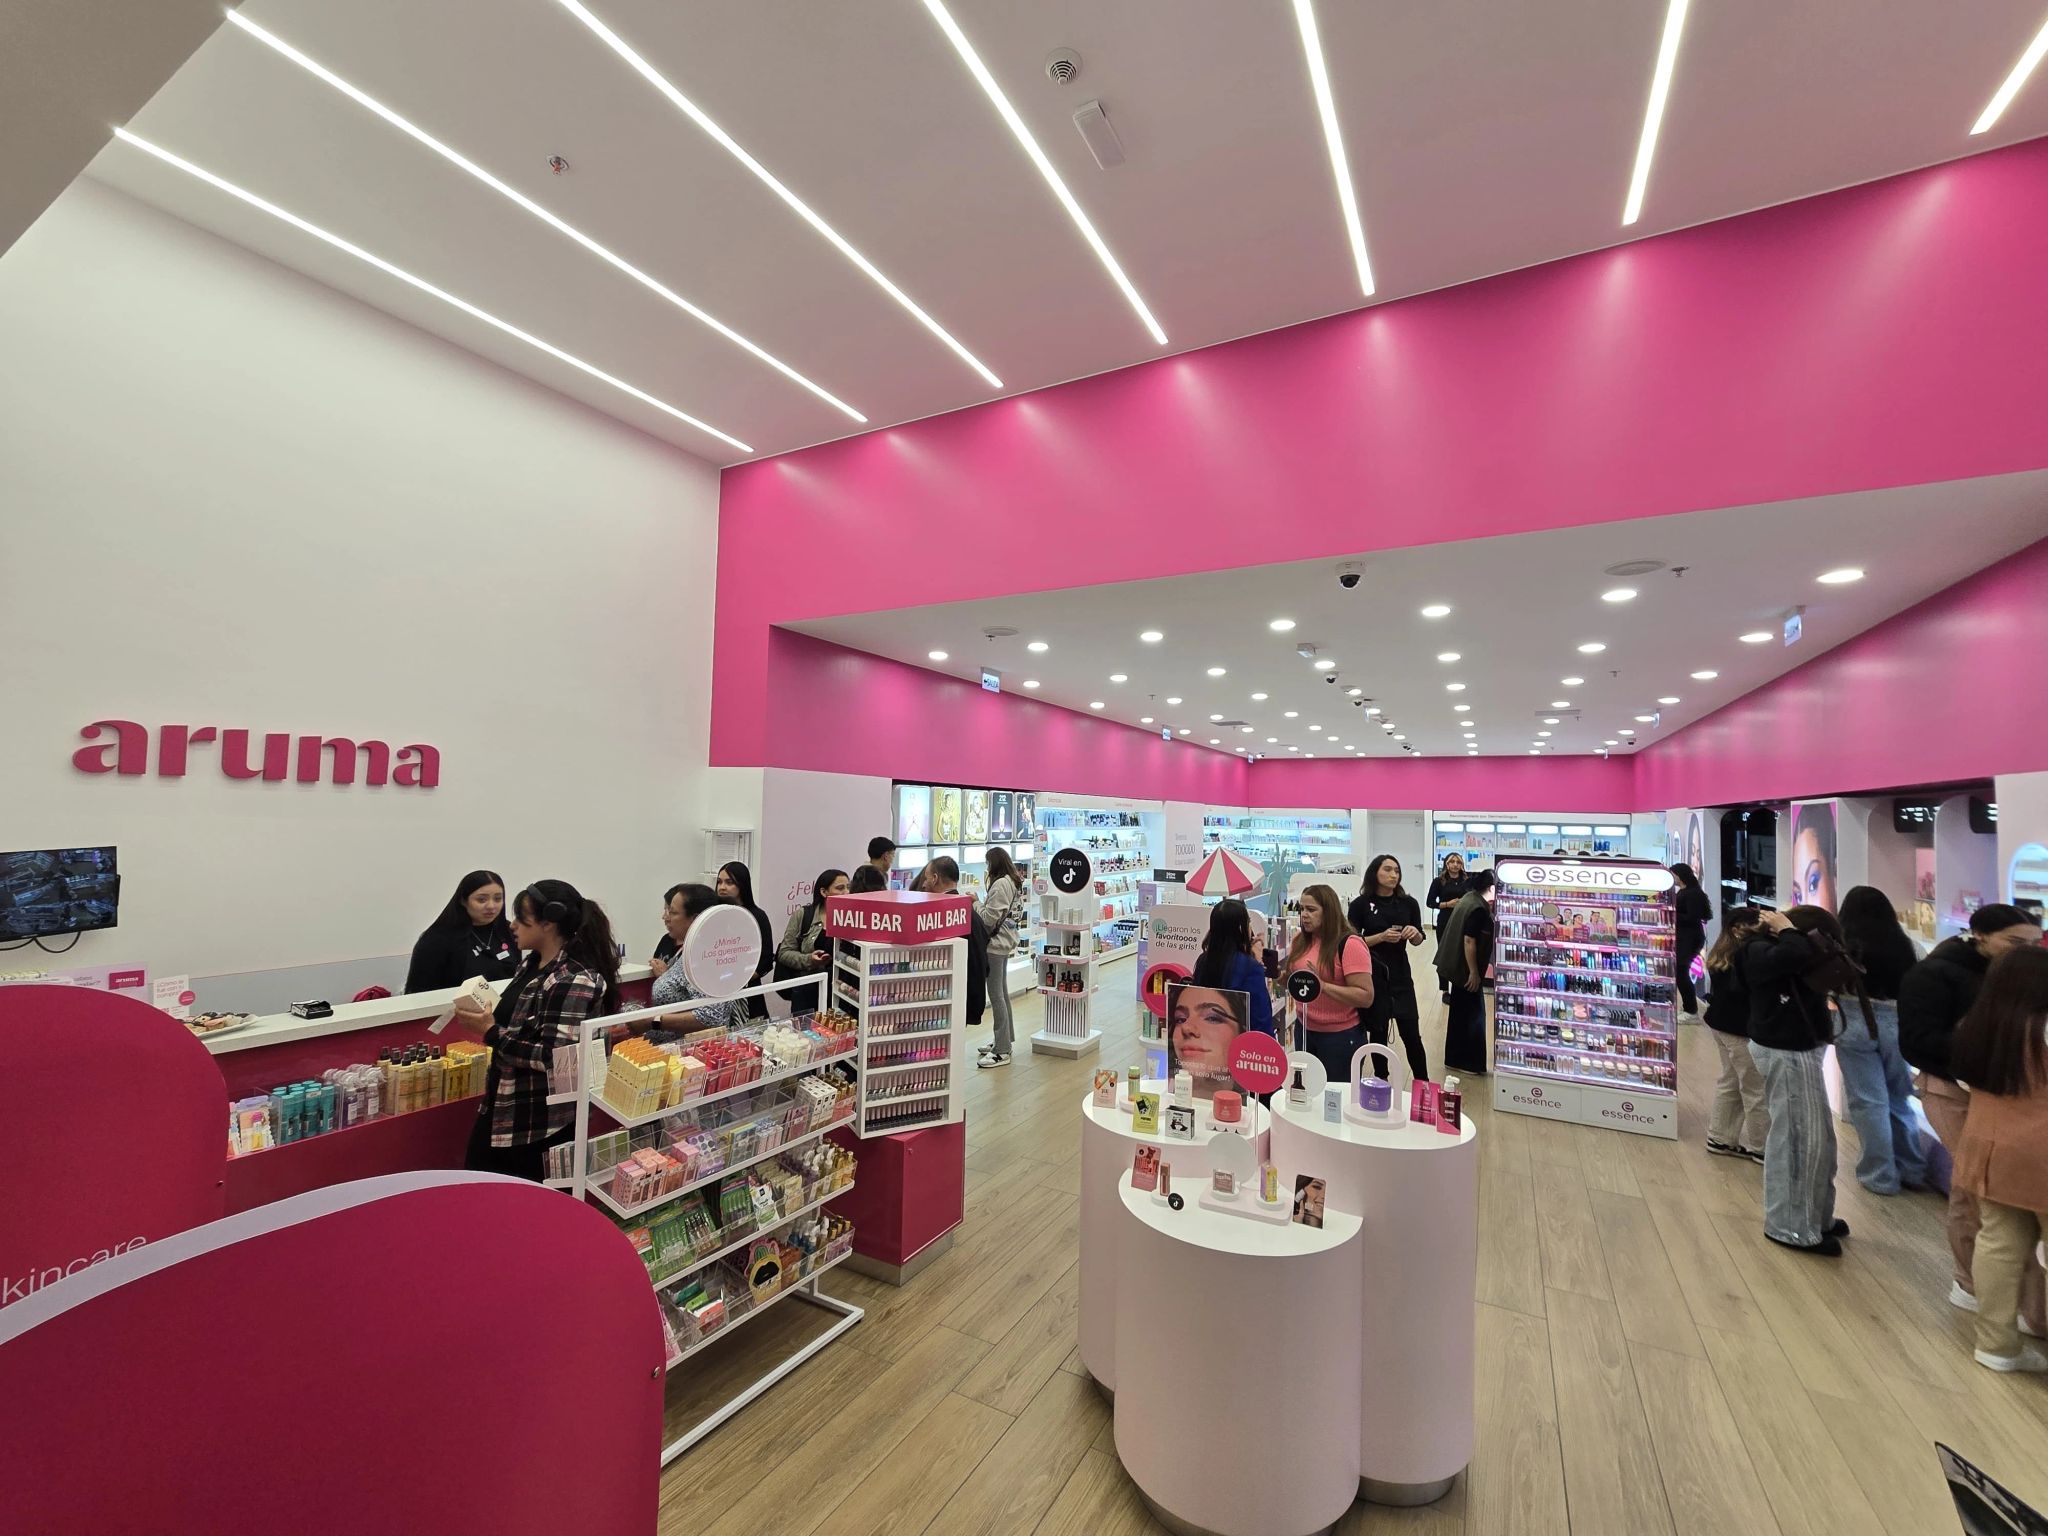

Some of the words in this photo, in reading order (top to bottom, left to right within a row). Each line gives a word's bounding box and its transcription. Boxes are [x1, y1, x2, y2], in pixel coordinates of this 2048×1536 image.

[73, 719, 441, 787] aruma
[1058, 858, 1072, 866] Viral
[1526, 866, 1641, 886] essence
[787, 880, 815, 901] ¿Fel
[833, 908, 867, 929] NAIL
[871, 912, 902, 933] BAR
[917, 911, 943, 932] NAIL
[946, 907, 966, 927] BAR
[1155, 924, 1189, 934] ¡Llegaron
[1191, 926, 1201, 935] los
[1155, 932, 1197, 942] favoritooos
[714, 936, 741, 949] ¿Minis?
[1155, 940, 1165, 948] de
[1167, 941, 1177, 949] las
[1179, 943, 1198, 951] girls!
[702, 950, 717, 961] ¡Los
[717, 945, 752, 957] queremos
[1239, 1049, 1261, 1061] Solo
[1263, 1055, 1276, 1064] en
[1236, 1059, 1280, 1076] aruma
[1211, 1072, 1231, 1082] lugar!
[1512, 1094, 1562, 1109] essence
[1601, 1108, 1655, 1125] essence
[1, 1235, 147, 1304] kincare
